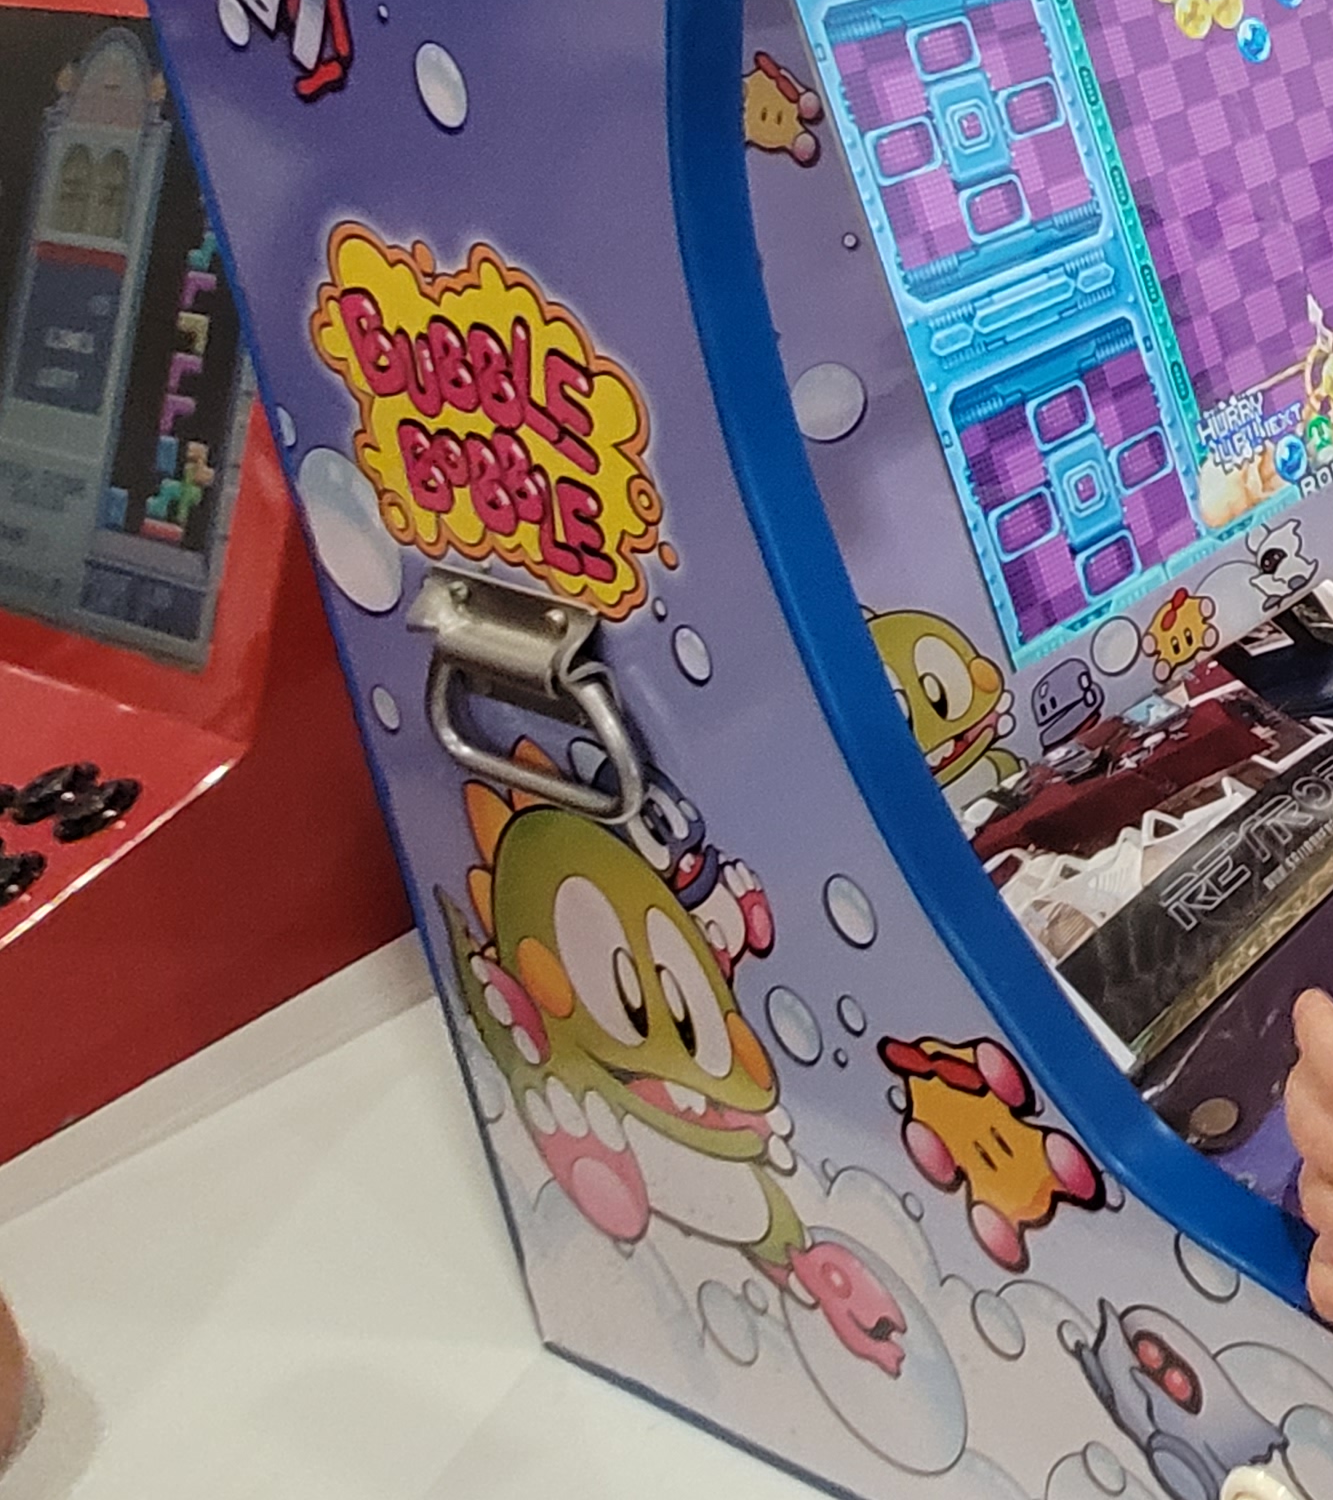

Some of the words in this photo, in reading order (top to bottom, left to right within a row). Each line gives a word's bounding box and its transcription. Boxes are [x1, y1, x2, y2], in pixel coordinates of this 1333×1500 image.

[339, 287, 598, 475] BUBBLE
[1199, 391, 1264, 445] HURRY
[398, 417, 616, 583] BOBBLE
